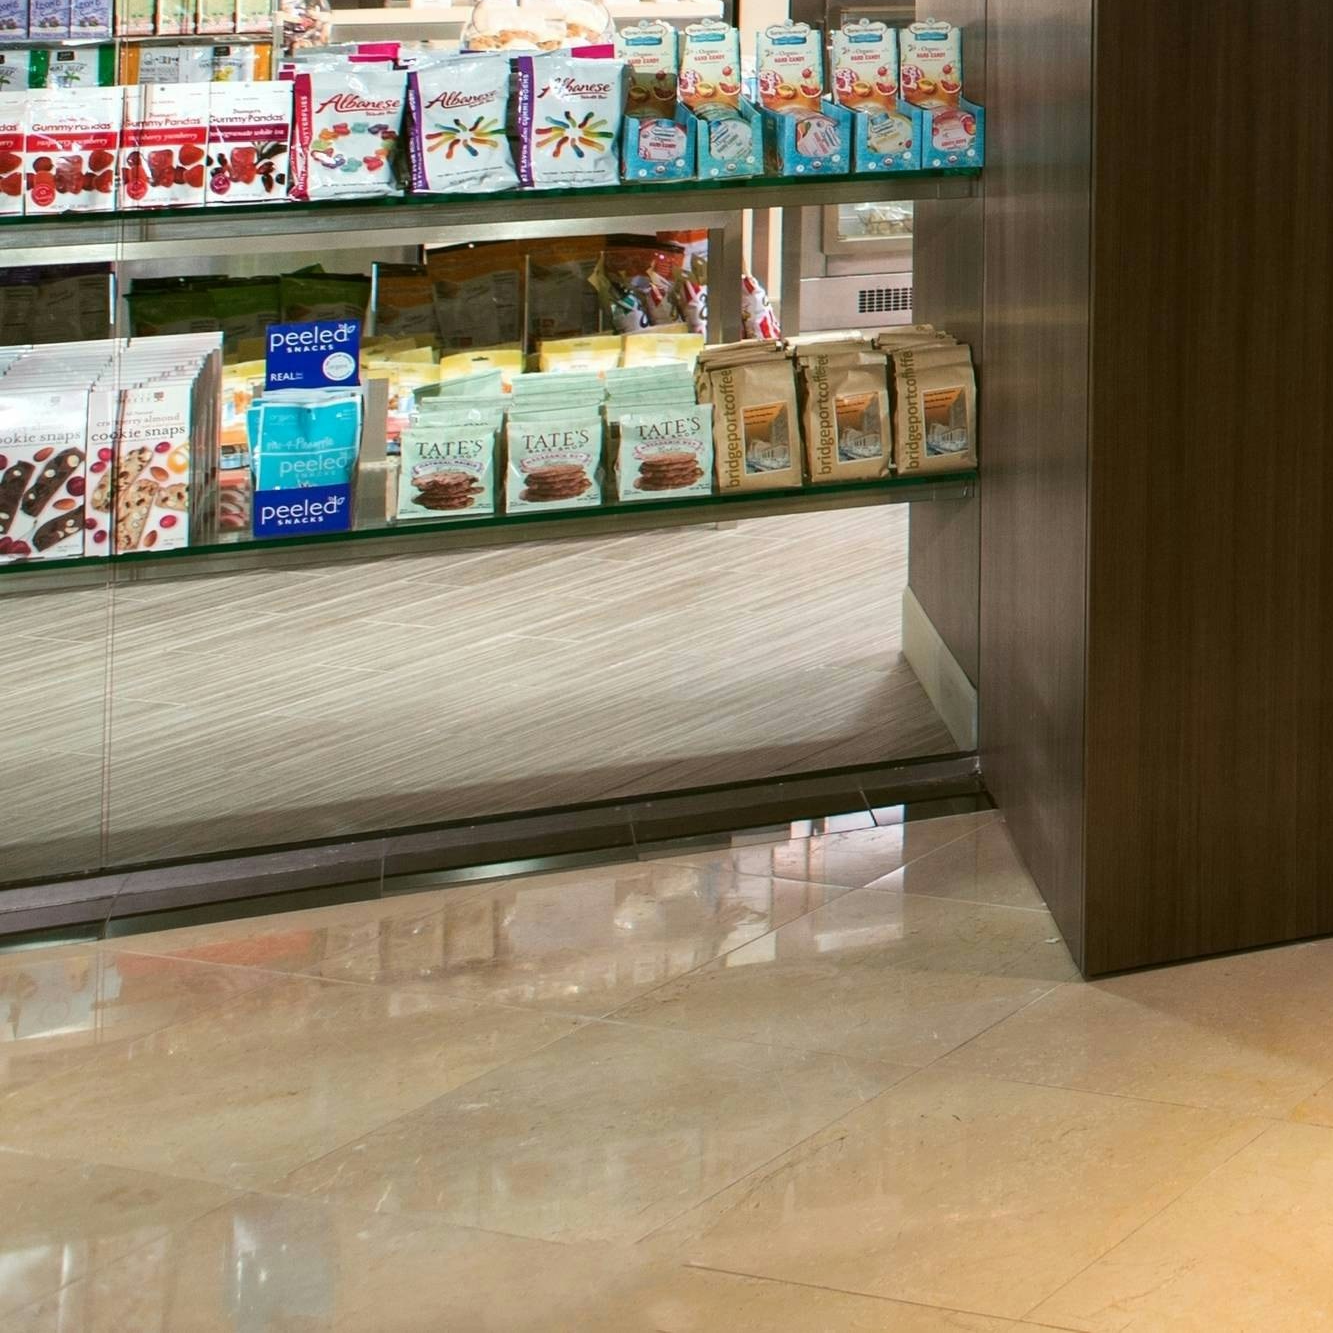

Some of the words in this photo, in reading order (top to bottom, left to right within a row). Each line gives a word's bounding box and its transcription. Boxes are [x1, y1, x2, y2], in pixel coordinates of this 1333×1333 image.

[315, 93, 400, 114] Albanese
[164, 117, 201, 126] Pandas
[209, 115, 246, 124] Gummy
[248, 113, 283, 122] Pandas
[0, 123, 17, 132] das
[32, 123, 74, 132] Gummy
[270, 323, 348, 352] peeled
[286, 344, 334, 353] SNACKS
[270, 372, 296, 381] REAL
[813, 354, 834, 476] bridgeportcoffee
[91, 428, 141, 442] cookie
[145, 425, 186, 440] snaps
[635, 416, 701, 437] TATE'S
[720, 369, 742, 488] bridgeportcoffee
[0, 432, 36, 446] ookie
[39, 431, 81, 444] snaps
[522, 429, 590, 450] TATE'S
[416, 439, 484, 456] TATE'S
[280, 450, 347, 477] peeled
[262, 496, 338, 525] peeled
[278, 516, 324, 526] SNACKS
